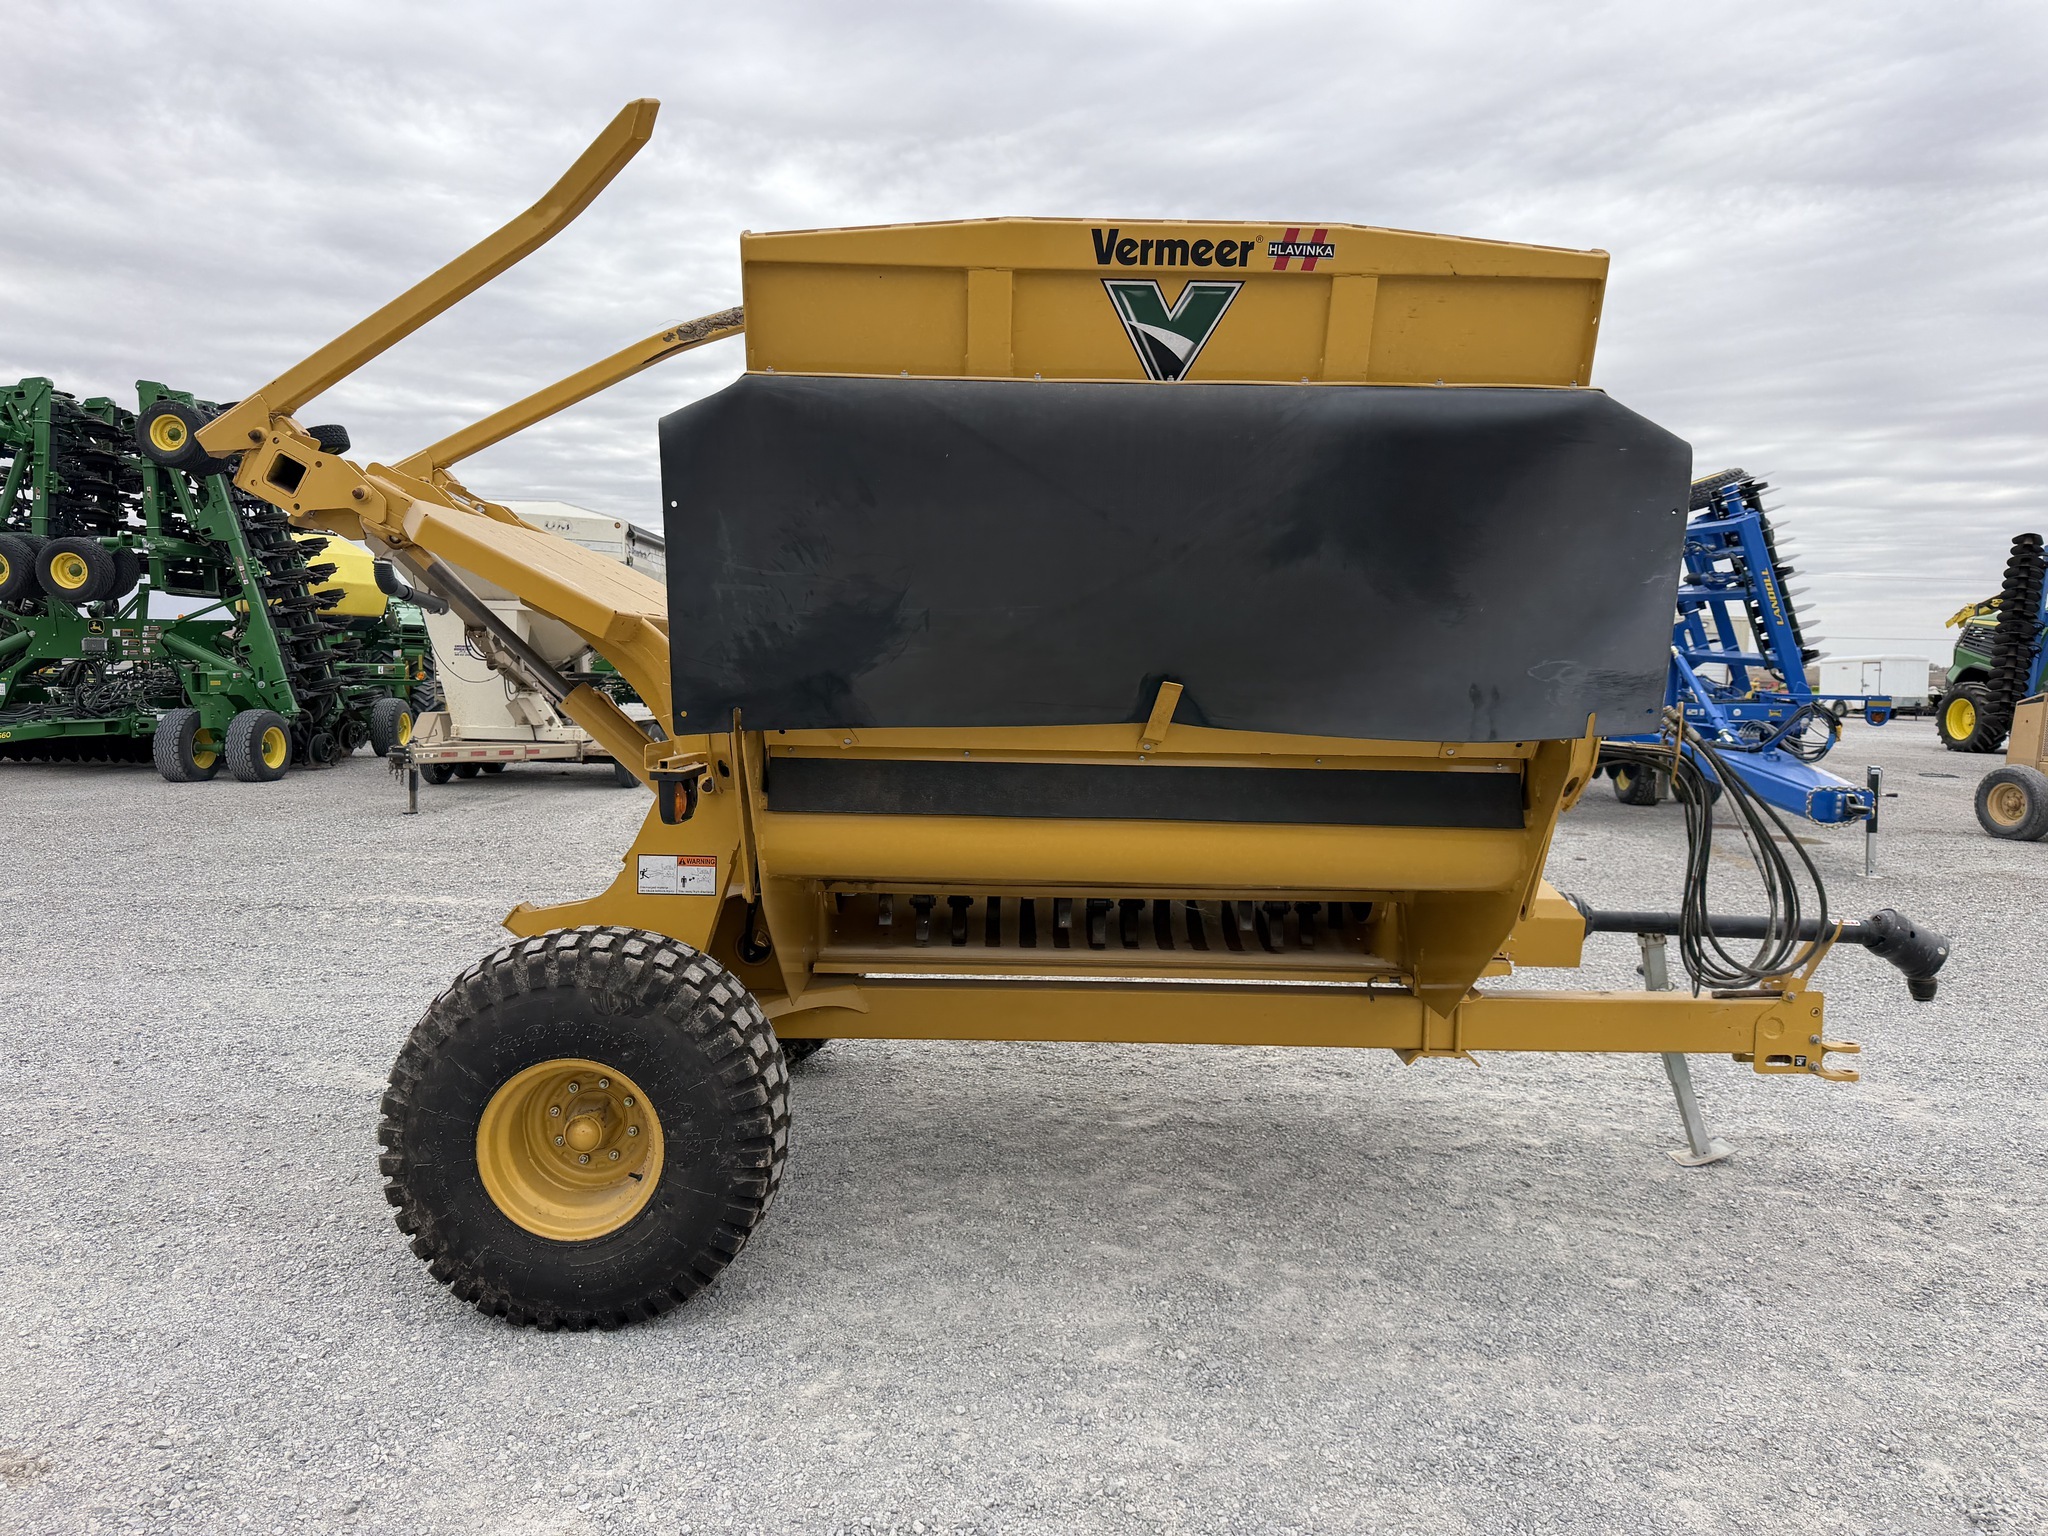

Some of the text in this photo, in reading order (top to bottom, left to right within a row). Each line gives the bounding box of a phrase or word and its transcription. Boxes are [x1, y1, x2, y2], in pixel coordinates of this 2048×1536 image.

[1091, 228, 1255, 267] Vermeer
[1268, 243, 1334, 257] HLAVINKA
[1761, 567, 1784, 626] LANDOLL
